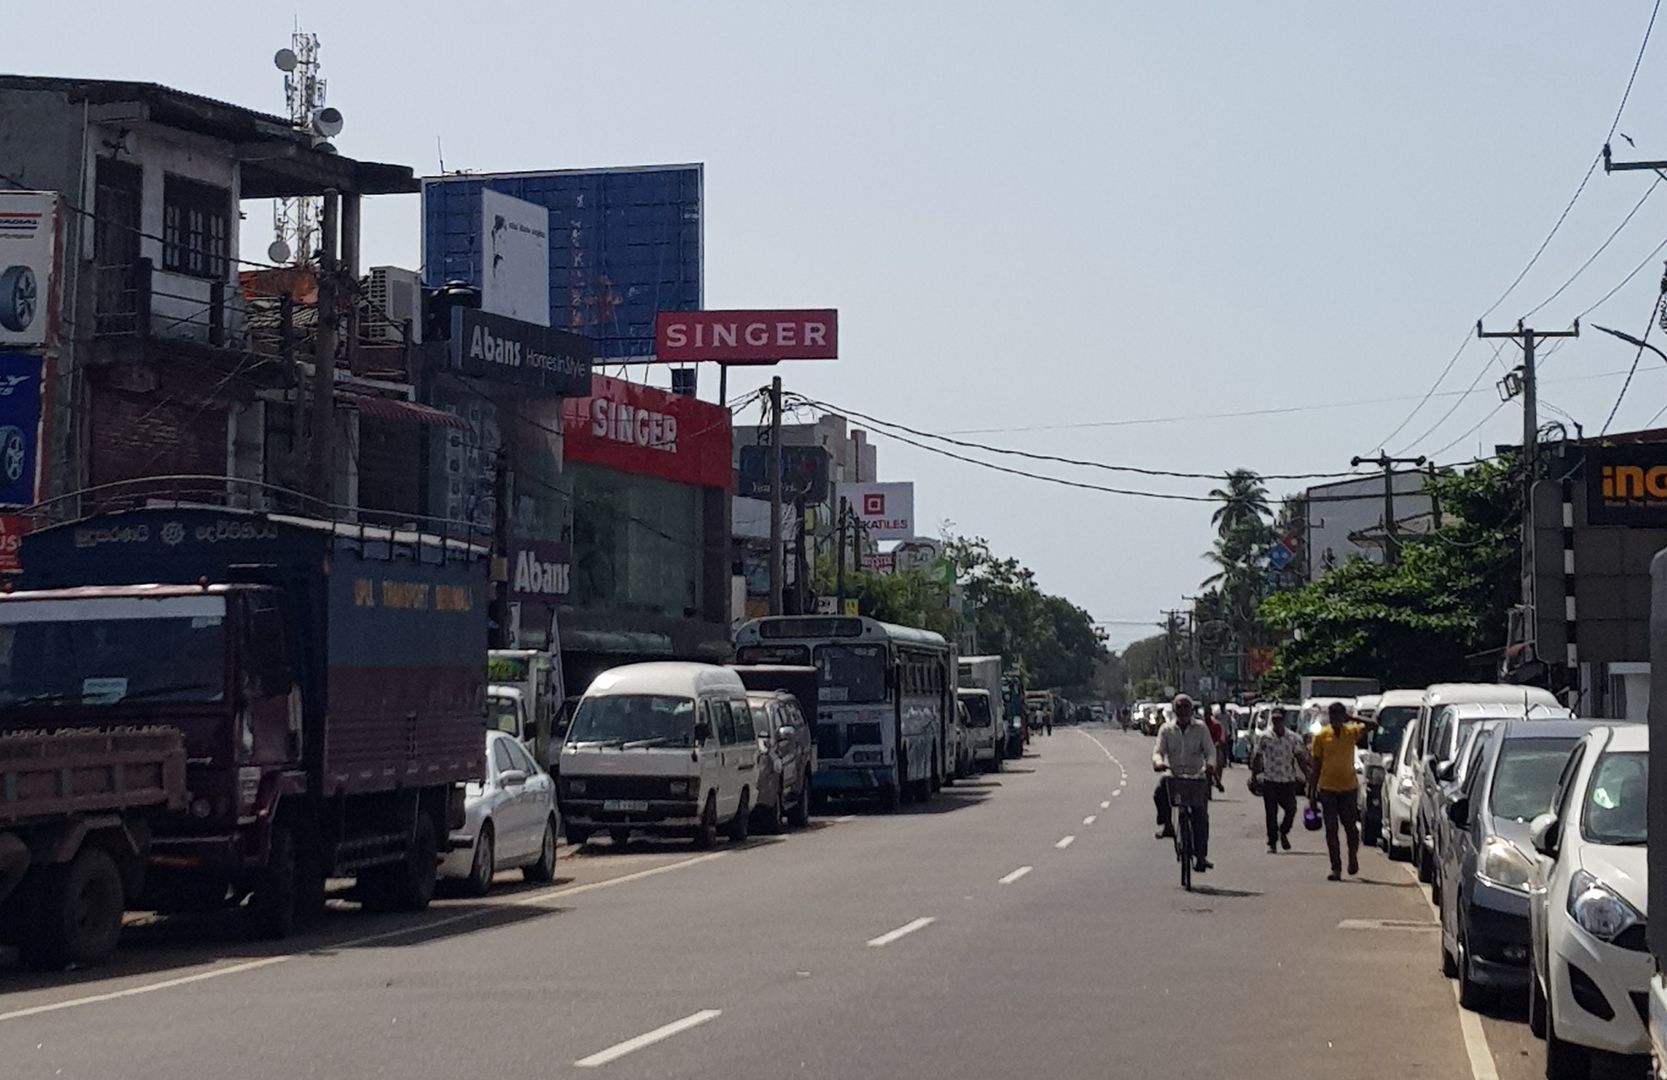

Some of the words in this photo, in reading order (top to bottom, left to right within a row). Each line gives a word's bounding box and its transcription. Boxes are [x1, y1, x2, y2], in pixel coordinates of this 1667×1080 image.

[470, 324, 521, 367] Abans
[666, 322, 827, 348] SINGER
[592, 399, 677, 453] SINGER
[513, 550, 570, 595] Abans
